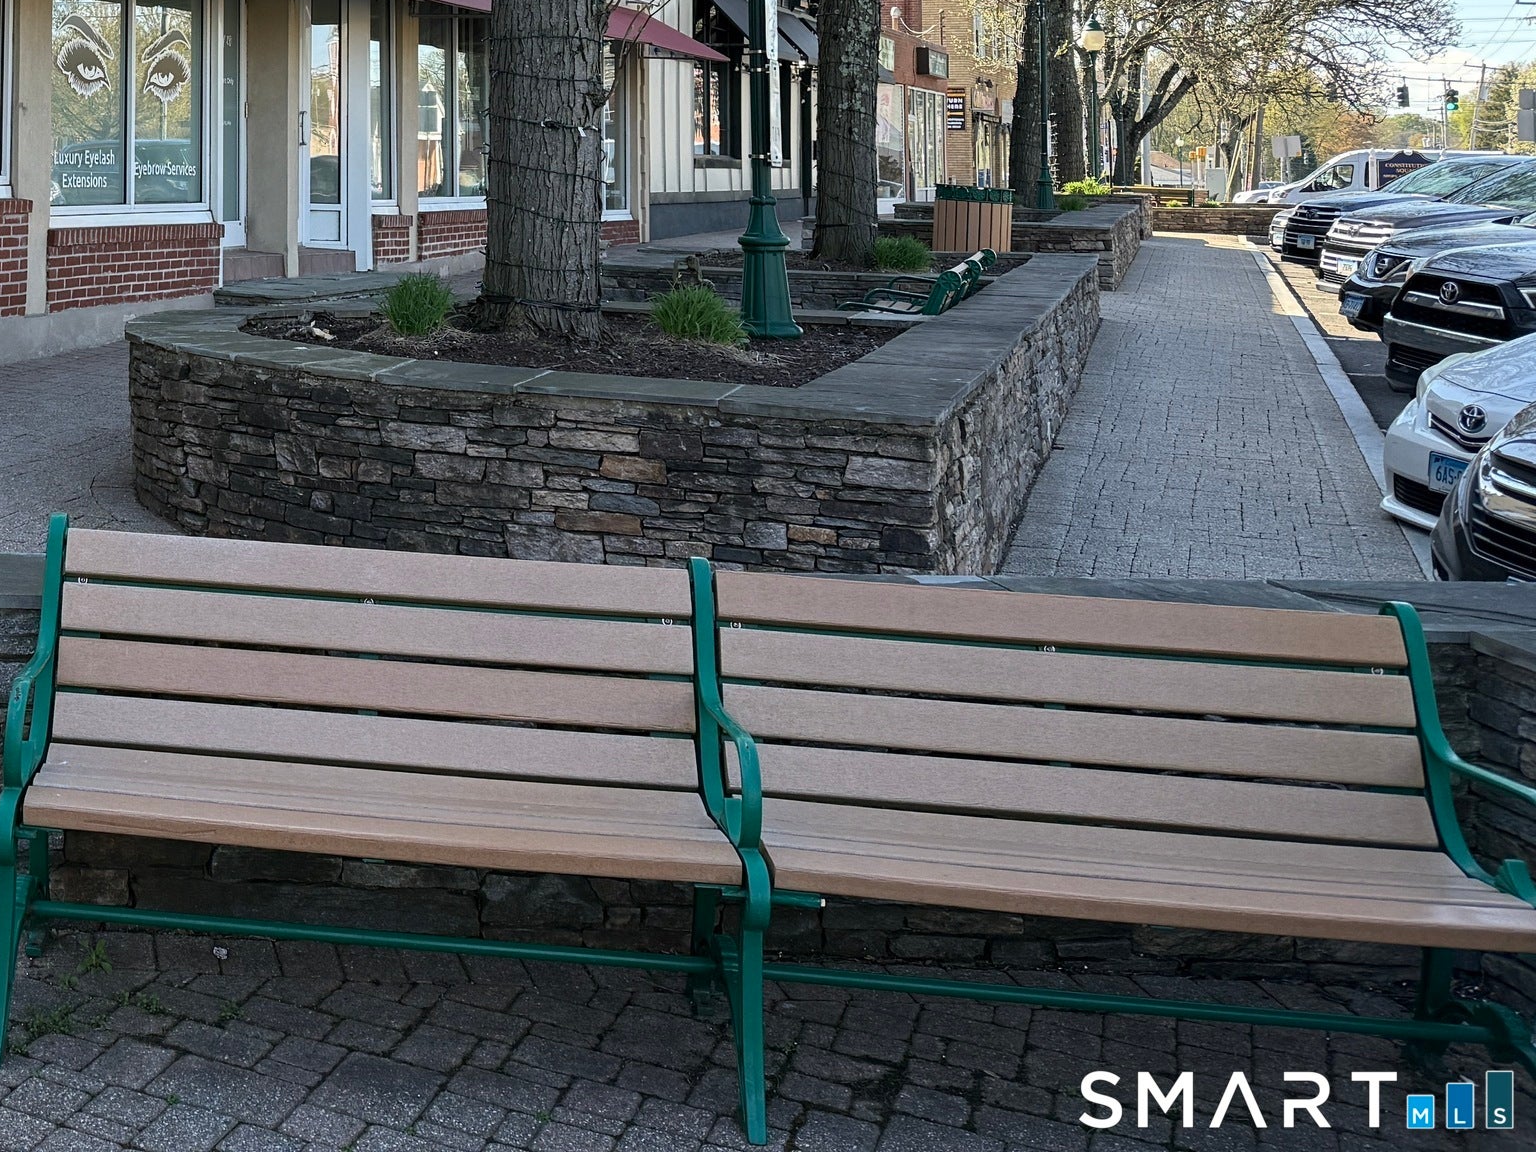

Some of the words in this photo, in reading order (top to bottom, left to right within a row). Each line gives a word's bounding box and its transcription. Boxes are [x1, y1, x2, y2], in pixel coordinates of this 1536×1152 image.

[53, 150, 84, 168] Luxury
[84, 150, 115, 165] Eyelash
[134, 161, 167, 177] Eyebrow
[166, 161, 197, 177] Services
[62, 172, 108, 189] Extensions
